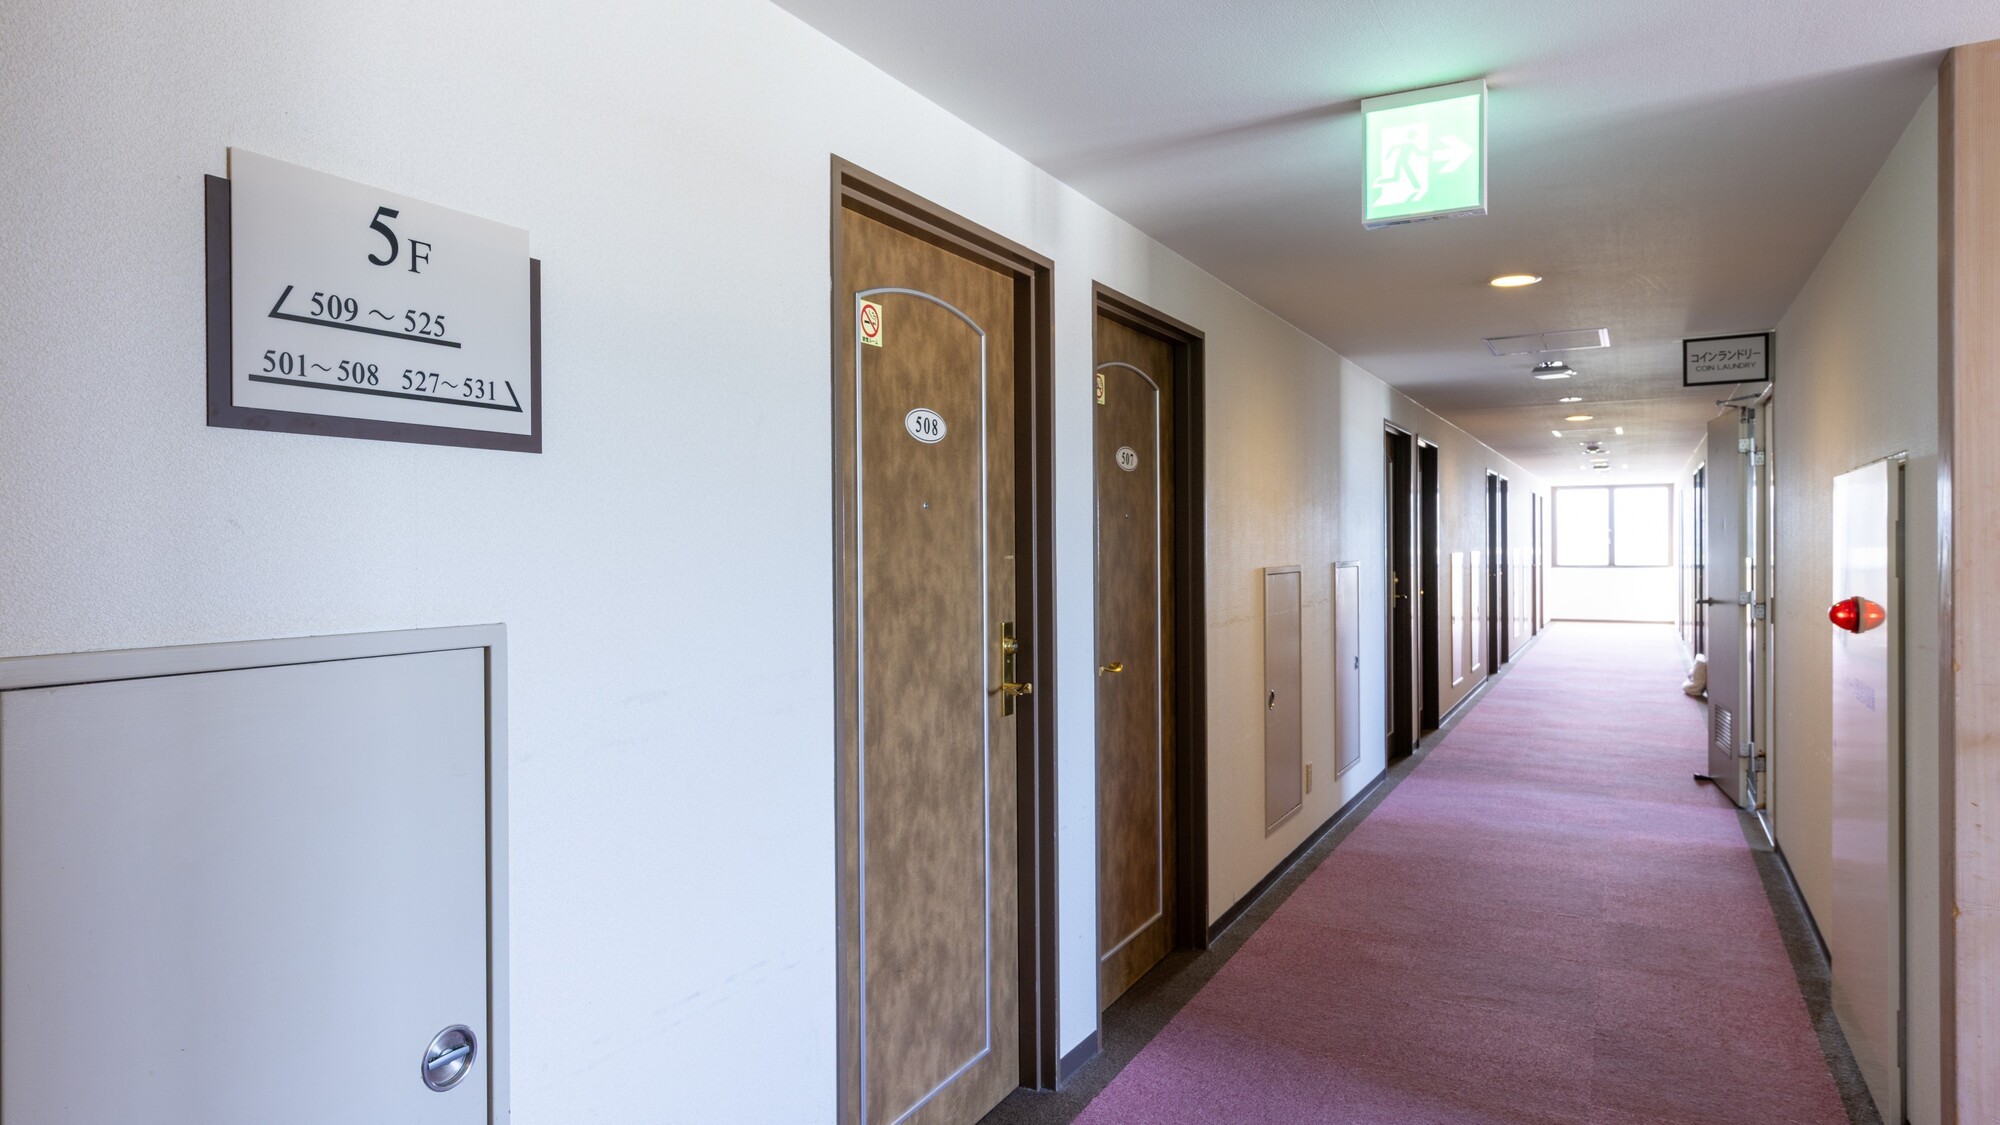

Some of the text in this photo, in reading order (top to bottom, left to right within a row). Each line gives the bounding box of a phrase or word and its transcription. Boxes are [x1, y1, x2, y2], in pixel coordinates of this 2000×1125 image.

[310, 291, 359, 323] 509
[404, 309, 446, 338] 525
[1690, 348, 1761, 363] コインランドリー
[1695, 361, 1757, 373] COIN LAUNDRY
[915, 416, 939, 436] 508
[1121, 452, 1134, 466] 507
